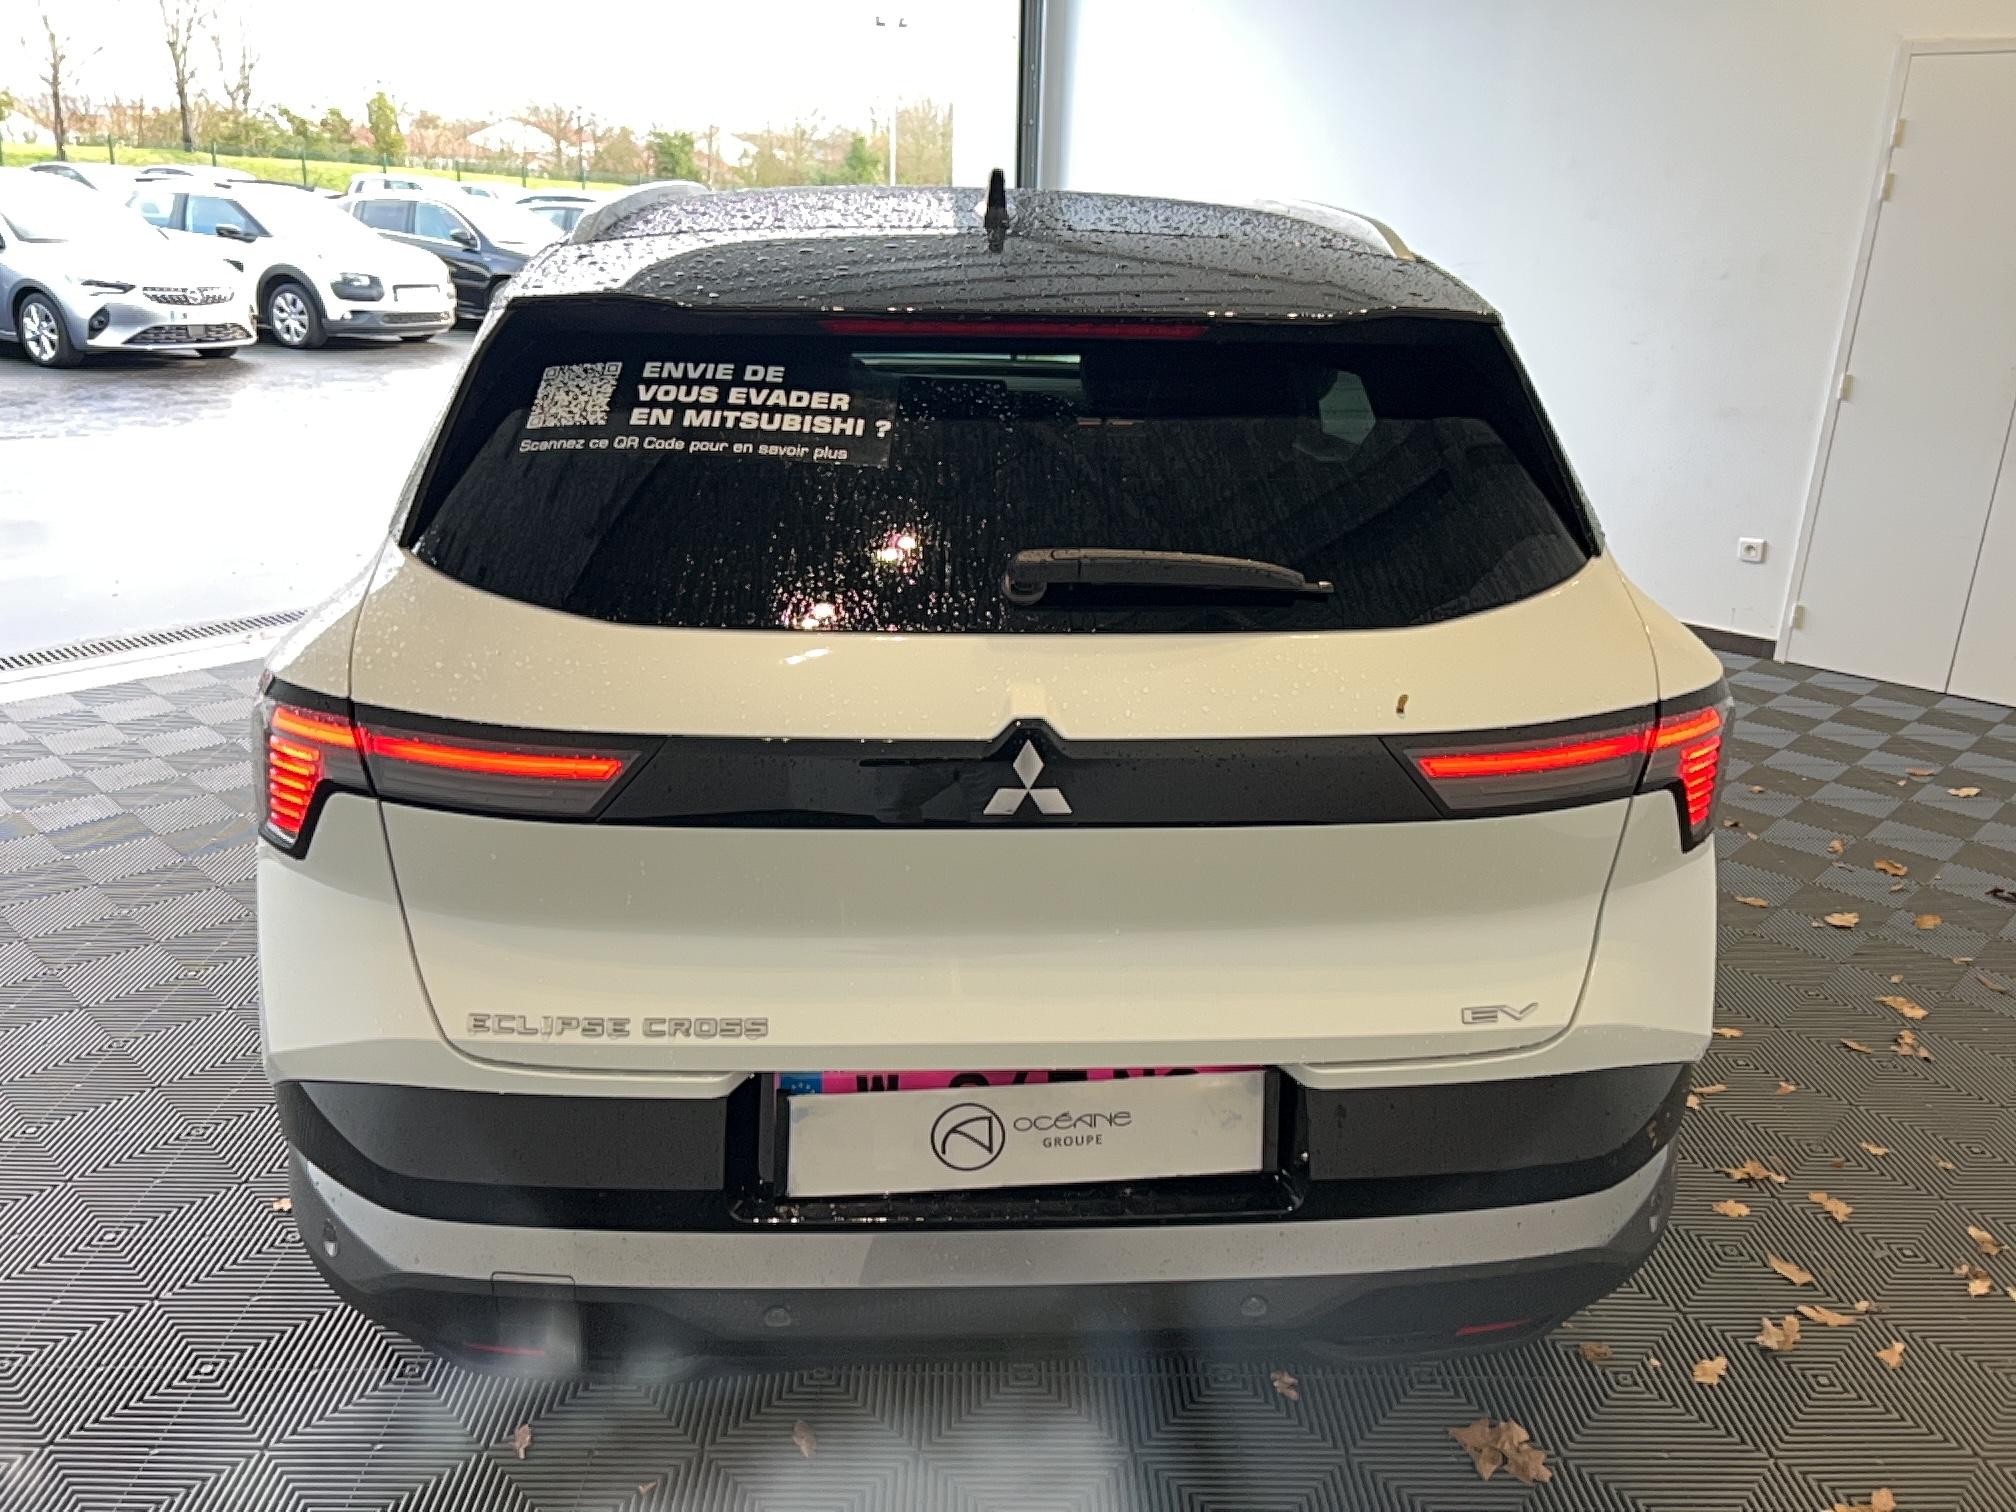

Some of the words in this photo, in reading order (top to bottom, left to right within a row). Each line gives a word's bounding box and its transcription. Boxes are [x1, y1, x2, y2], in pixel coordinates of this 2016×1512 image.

[642, 361, 735, 381] ENVIE
[744, 364, 786, 383] DE
[637, 384, 719, 404] VOUS
[728, 386, 851, 412] EVADER
[629, 407, 674, 426] EN
[682, 409, 866, 437] MITSUBISHI
[875, 419, 893, 438] ?
[519, 438, 585, 452] Scannez
[588, 438, 609, 449] ce
[613, 435, 640, 449] QR
[643, 436, 685, 450] Code
[689, 439, 730, 453] pour
[733, 442, 753, 454] en
[758, 443, 809, 458] savoir
[813, 445, 848, 462] plus
[467, 1012, 631, 1038] ECLIPSE
[642, 1017, 769, 1038] CROSS
[1461, 1002, 1539, 1025] EV
[1042, 1134, 1103, 1148] GROUPE
